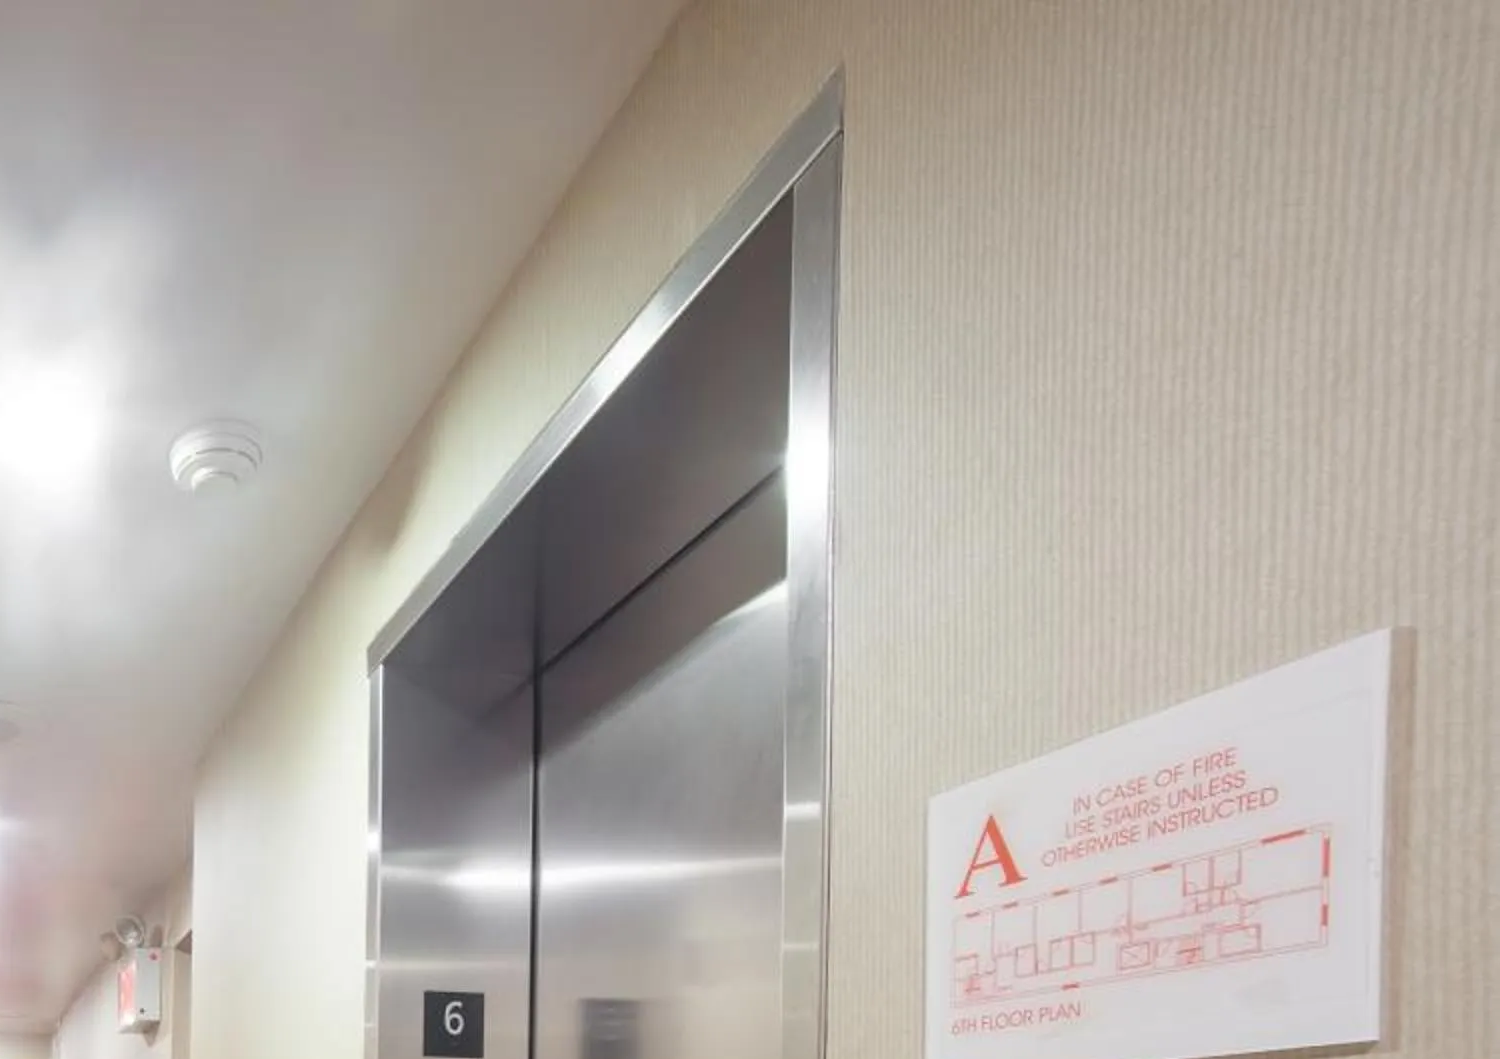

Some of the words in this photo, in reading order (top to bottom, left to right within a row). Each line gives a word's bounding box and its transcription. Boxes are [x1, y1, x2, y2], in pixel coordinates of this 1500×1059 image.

[1065, 815, 1095, 840] USE
[1101, 797, 1161, 829] STAIRS
[1168, 770, 1246, 809] UNLESS
[1073, 794, 1091, 816] IN
[1097, 776, 1148, 807] CASE
[1154, 763, 1185, 788] OF
[1193, 747, 1238, 777] FIRE
[955, 813, 1028, 898] A
[1041, 825, 1141, 868] OTHERWISE
[1147, 787, 1279, 838] INSTRUCTED
[444, 1001, 465, 1035] 6
[951, 1018, 977, 1036] 6TH
[981, 1009, 1033, 1032] FLOOR
[1039, 1002, 1081, 1023] PLAN
